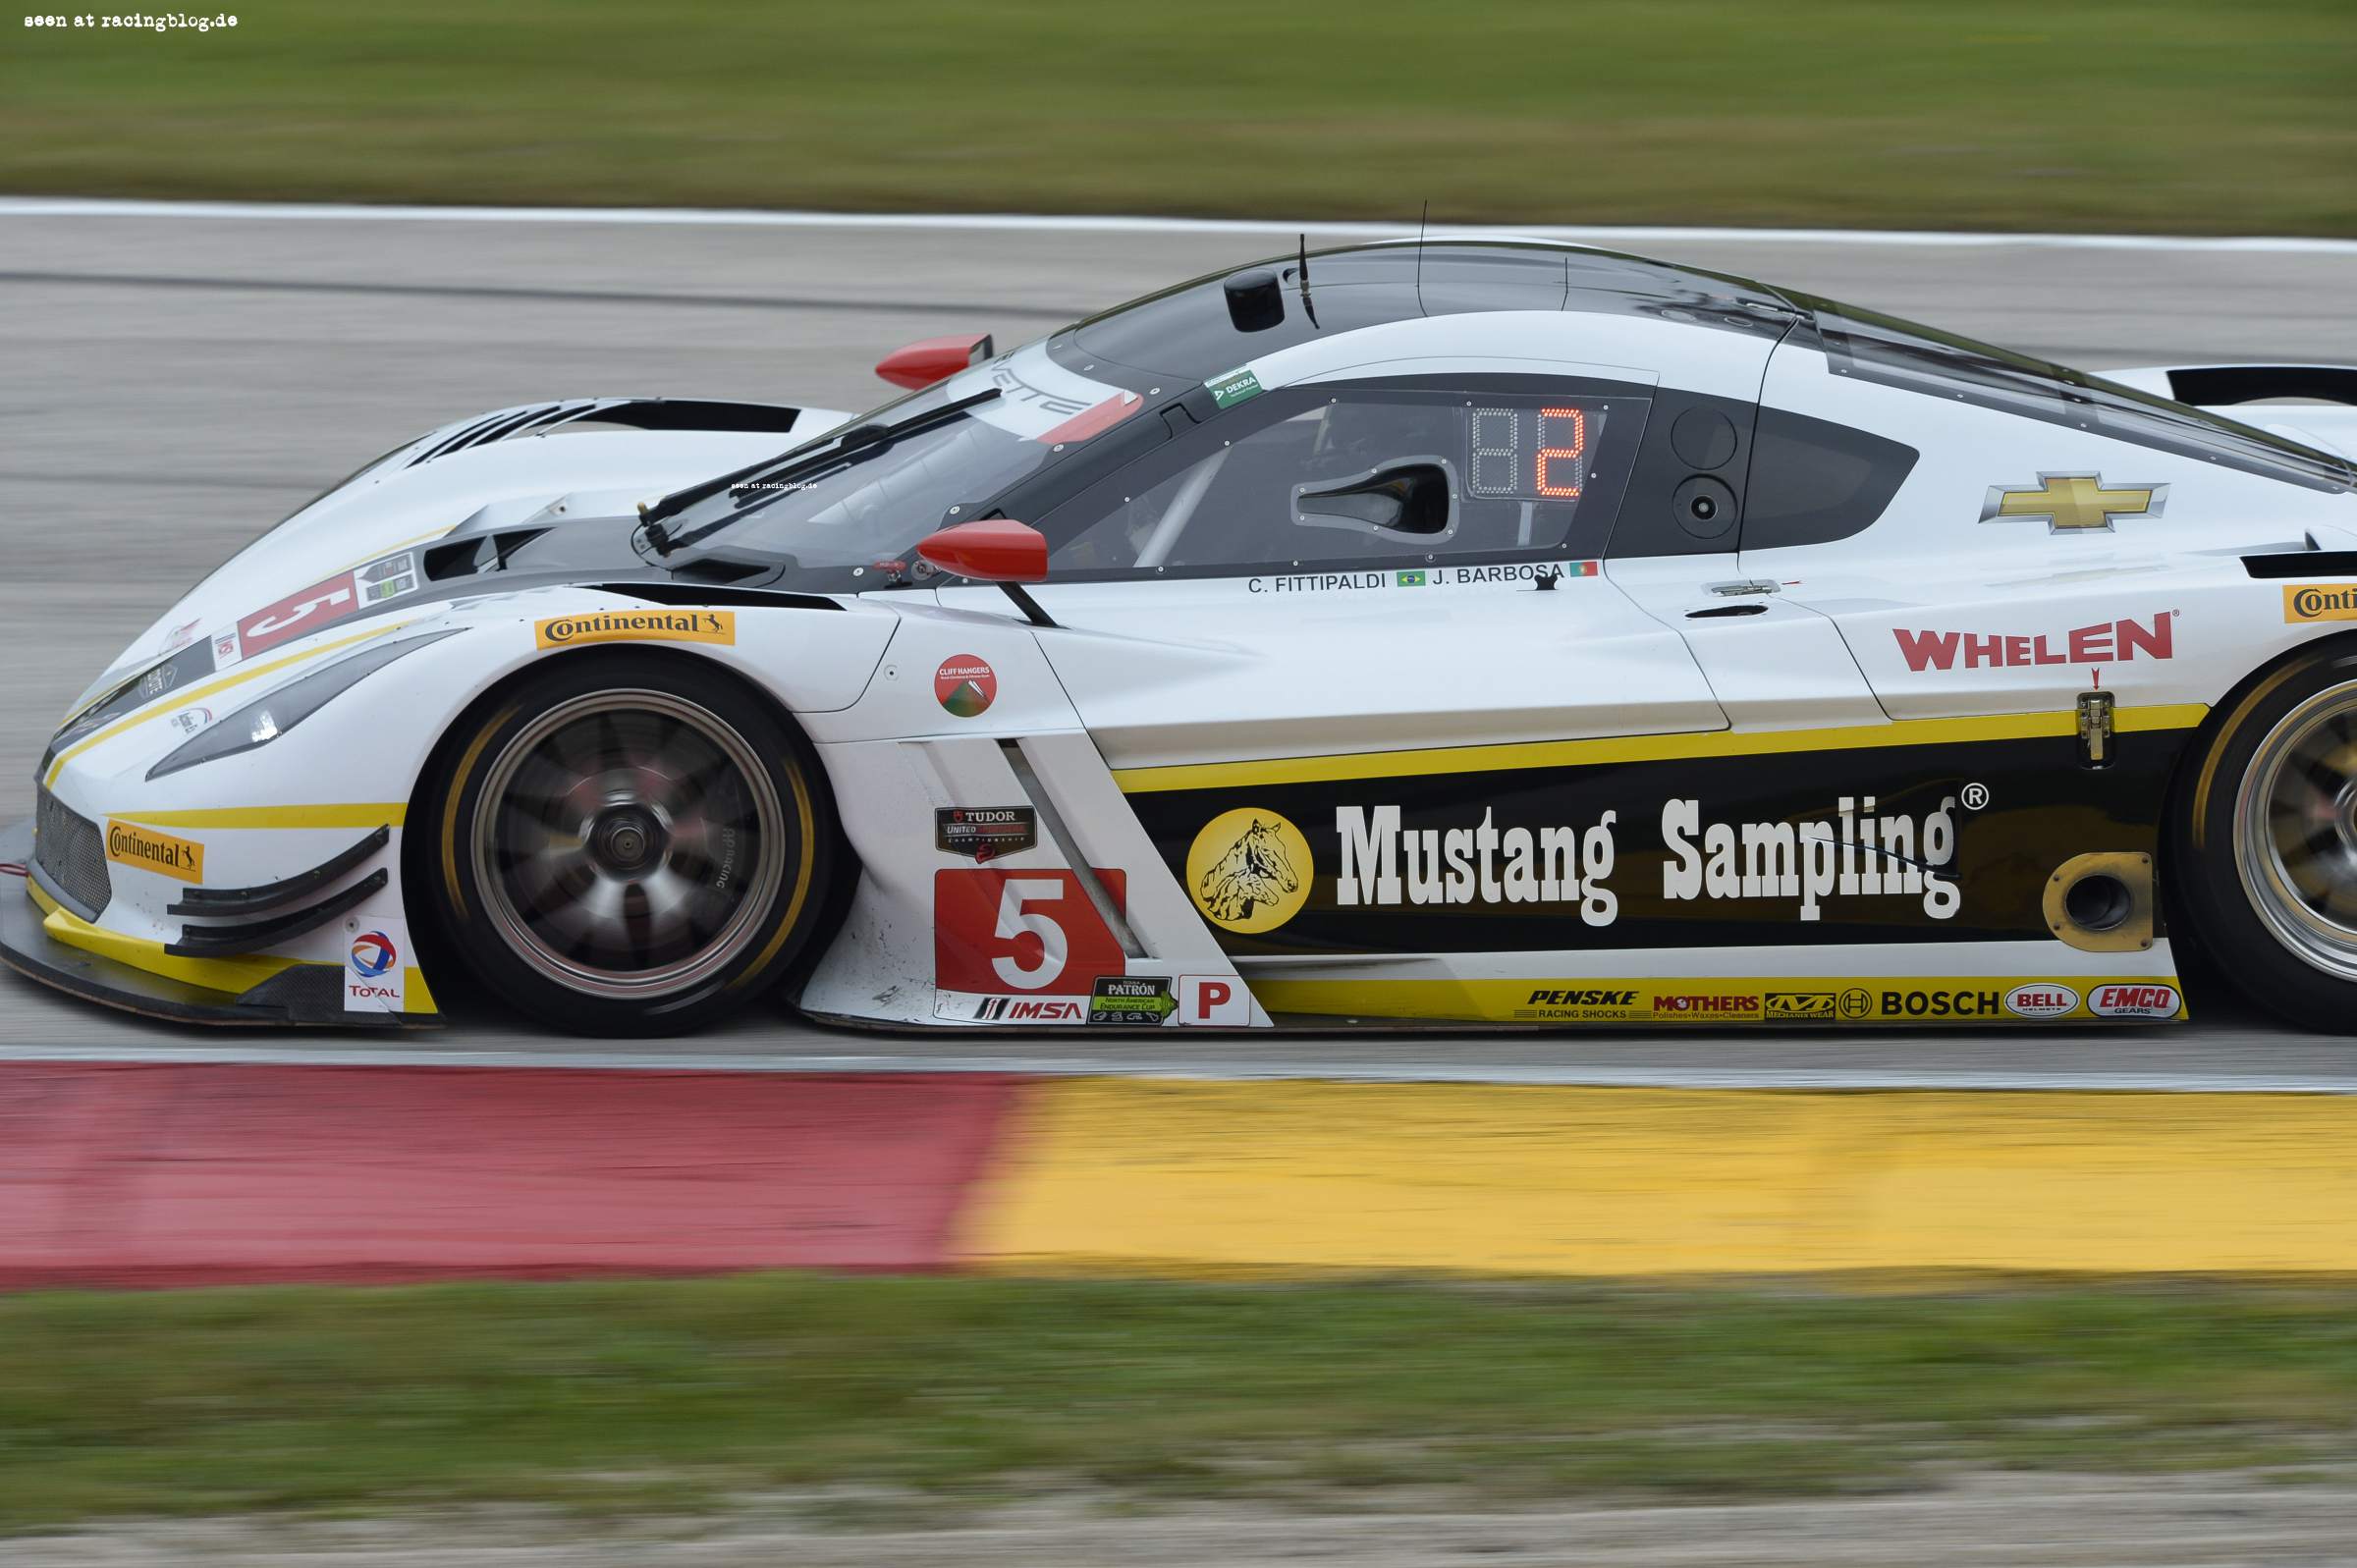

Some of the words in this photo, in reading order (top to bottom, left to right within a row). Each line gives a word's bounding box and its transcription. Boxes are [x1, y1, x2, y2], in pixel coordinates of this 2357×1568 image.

[1226, 376, 1257, 394] DEKRA
[1248, 577, 1268, 594] C.
[1276, 572, 1387, 592] FITTIPALDI
[1432, 569, 1451, 586] J.
[1457, 563, 1565, 585] BARBOSA
[544, 613, 700, 642] Continental
[1891, 611, 2174, 672] WHELEN
[939, 667, 957, 676] CLIFF
[958, 666, 990, 676] HANGERS
[965, 811, 1015, 823] TUDOR
[947, 826, 977, 835] UNITED
[109, 826, 181, 868] Continental
[1336, 804, 1619, 927] Mustang
[1661, 795, 1961, 921] Sampling
[991, 879, 1069, 990] 5
[349, 985, 401, 999] TOTAL
[1108, 983, 1156, 996] PATRÓN
[1527, 990, 1640, 1005] PENSKE
[2099, 988, 2171, 1009] EMCO
[1197, 982, 1231, 1019] P
[1653, 996, 1760, 1011] MOTHERS
[1881, 991, 2000, 1015] BOSCH
[2017, 993, 2067, 1007] BELL
[1009, 1001, 1082, 1019] IMSA
[1538, 1009, 1579, 1019] RACING
[1582, 1009, 1627, 1019] SHOCKS
